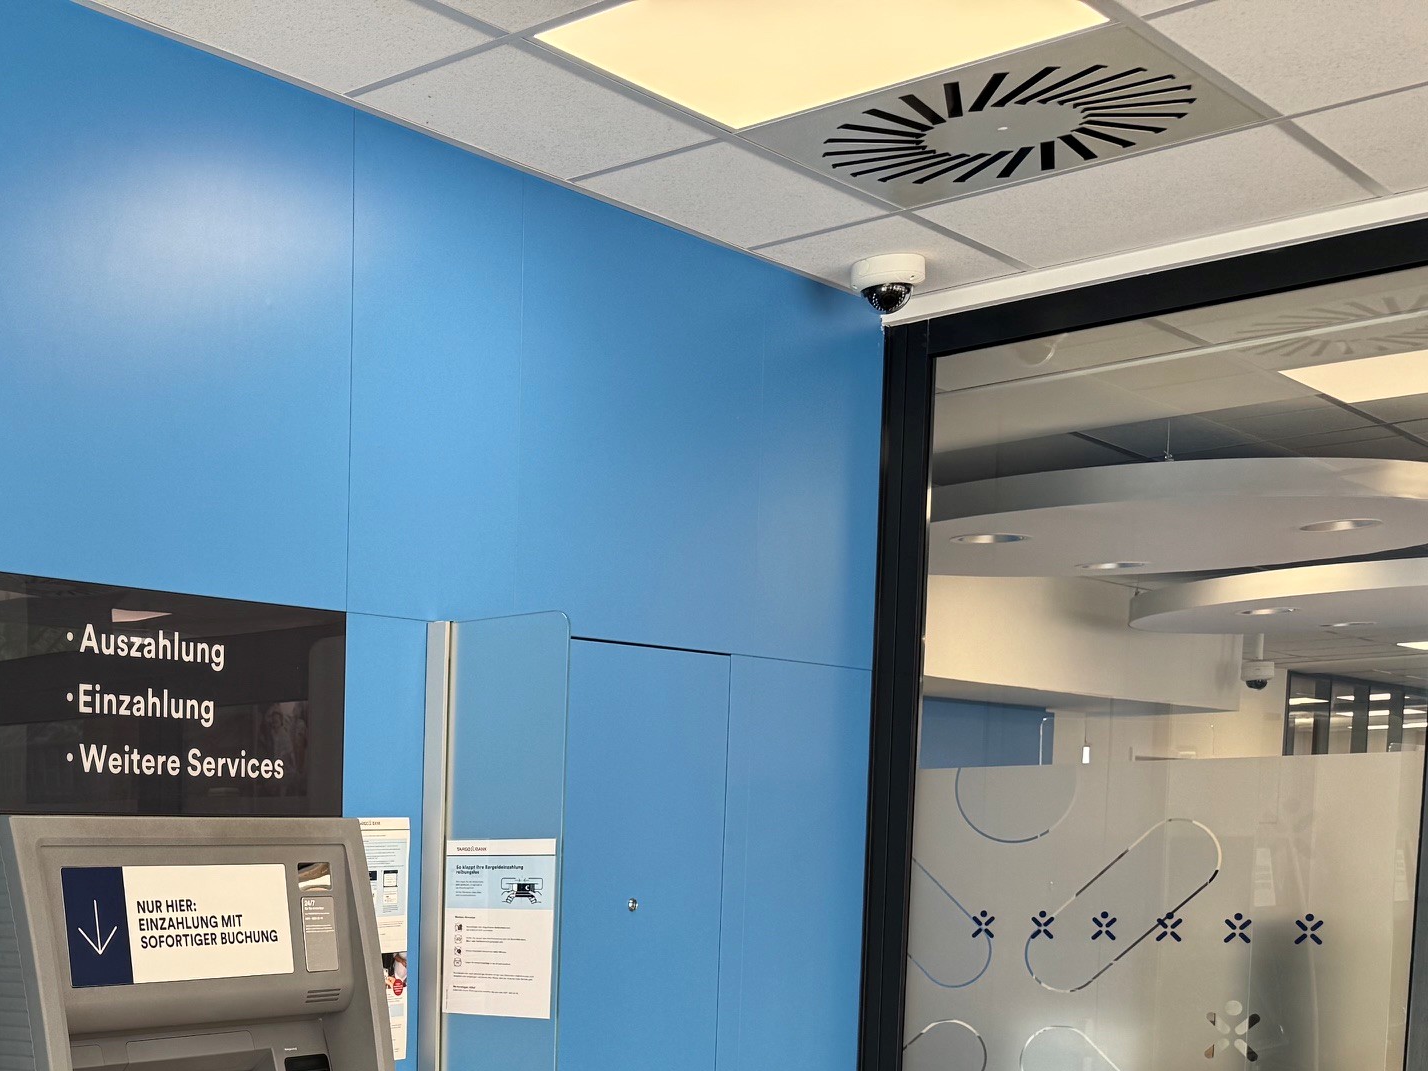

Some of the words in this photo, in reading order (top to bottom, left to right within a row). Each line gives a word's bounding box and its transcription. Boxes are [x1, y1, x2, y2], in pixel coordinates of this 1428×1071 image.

[79, 623, 225, 672] Auszahlung
[78, 683, 215, 728] Einzahlung
[79, 743, 181, 776] Weitere
[187, 748, 284, 779] Services
[136, 900, 162, 914] NUR
[165, 899, 197, 913] HIER:
[138, 915, 218, 931] EINZAHLUNG
[221, 914, 243, 928] MIT
[140, 932, 218, 949] SOFORTIGER
[221, 929, 278, 945] BUCHUNG
